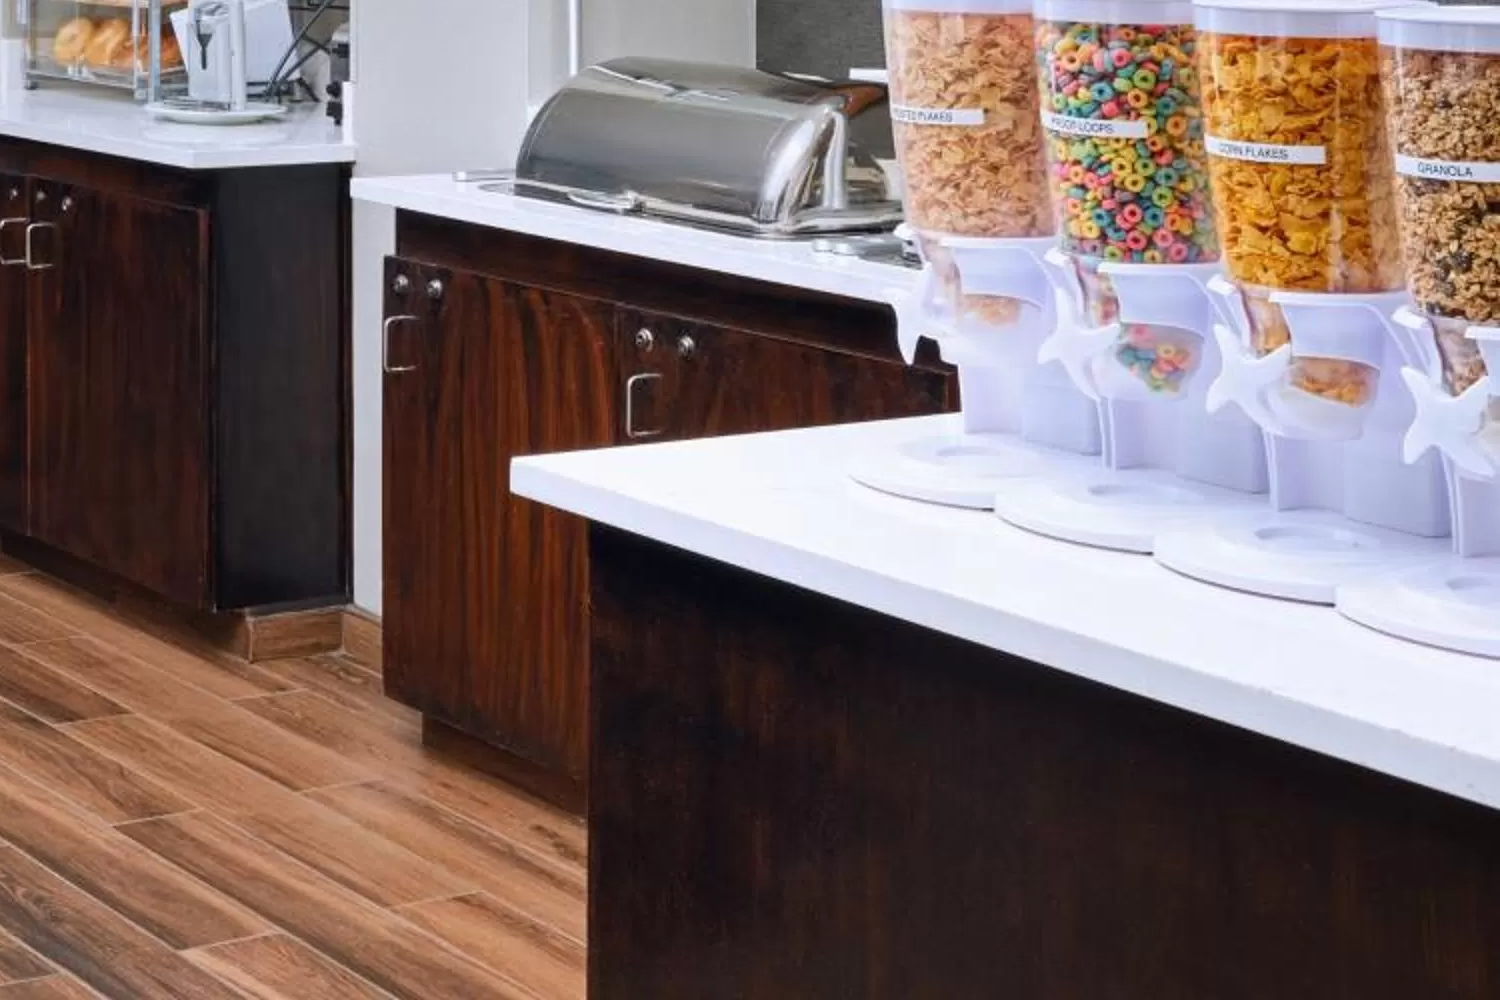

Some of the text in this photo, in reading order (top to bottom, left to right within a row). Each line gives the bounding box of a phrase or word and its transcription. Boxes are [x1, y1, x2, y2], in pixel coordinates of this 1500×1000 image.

[1079, 120, 1116, 134] LOOPS
[1245, 145, 1289, 160] FLAKES
[1417, 162, 1474, 178] GRANOLA
